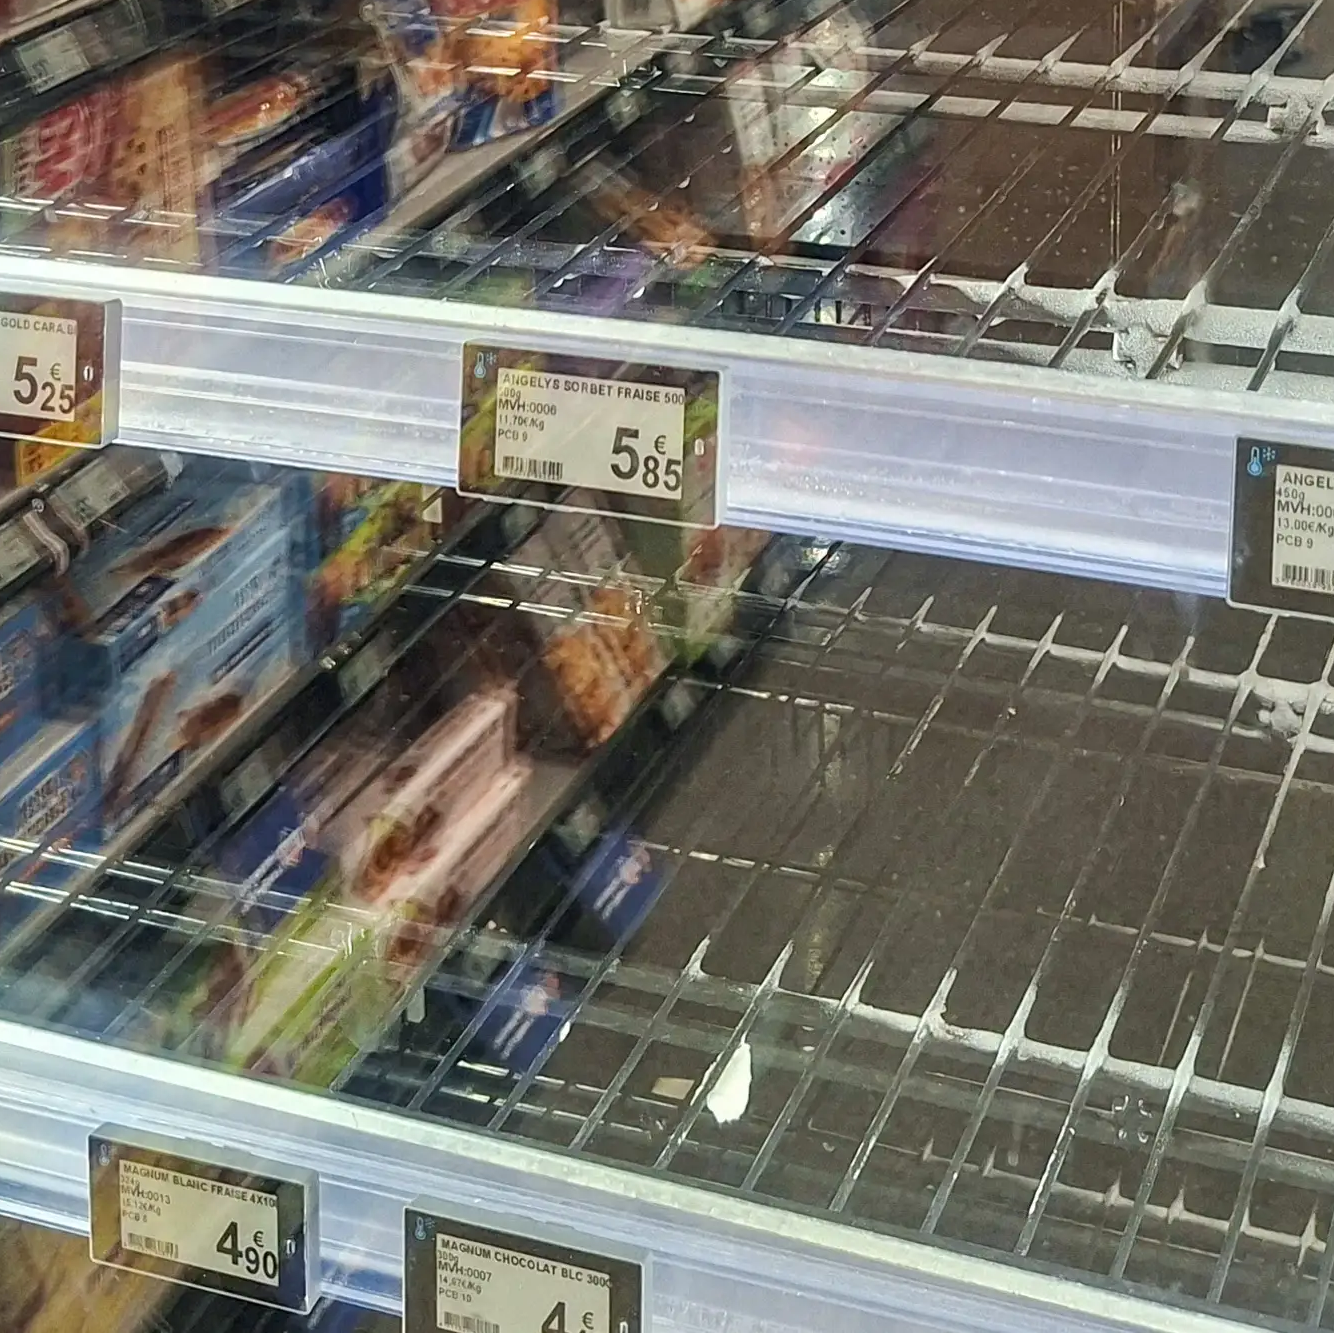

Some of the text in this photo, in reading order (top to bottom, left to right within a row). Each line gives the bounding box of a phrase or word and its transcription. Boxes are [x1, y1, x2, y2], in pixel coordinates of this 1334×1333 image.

[0, 317, 31, 331] GOLD
[13, 356, 38, 405] 5
[40, 381, 75, 415] 25
[564, 379, 613, 397] SORBET
[617, 386, 661, 402] FRAISE
[664, 392, 685, 406] 500
[610, 426, 682, 492] 5 € 85
[1276, 533, 1314, 549] PCB 9
[123, 1164, 169, 1182] MAGNUM
[172, 1175, 208, 1193] BLANC
[211, 1185, 248, 1202] FRAISE
[216, 1221, 278, 1279] 4 € 90
[441, 1238, 493, 1260] MAGNUM
[495, 1251, 558, 1276] CHOCOLAT
[561, 1268, 584, 1283] BLC
[438, 1261, 493, 1282] MVH:0007
[439, 1287, 459, 1300] PCB
